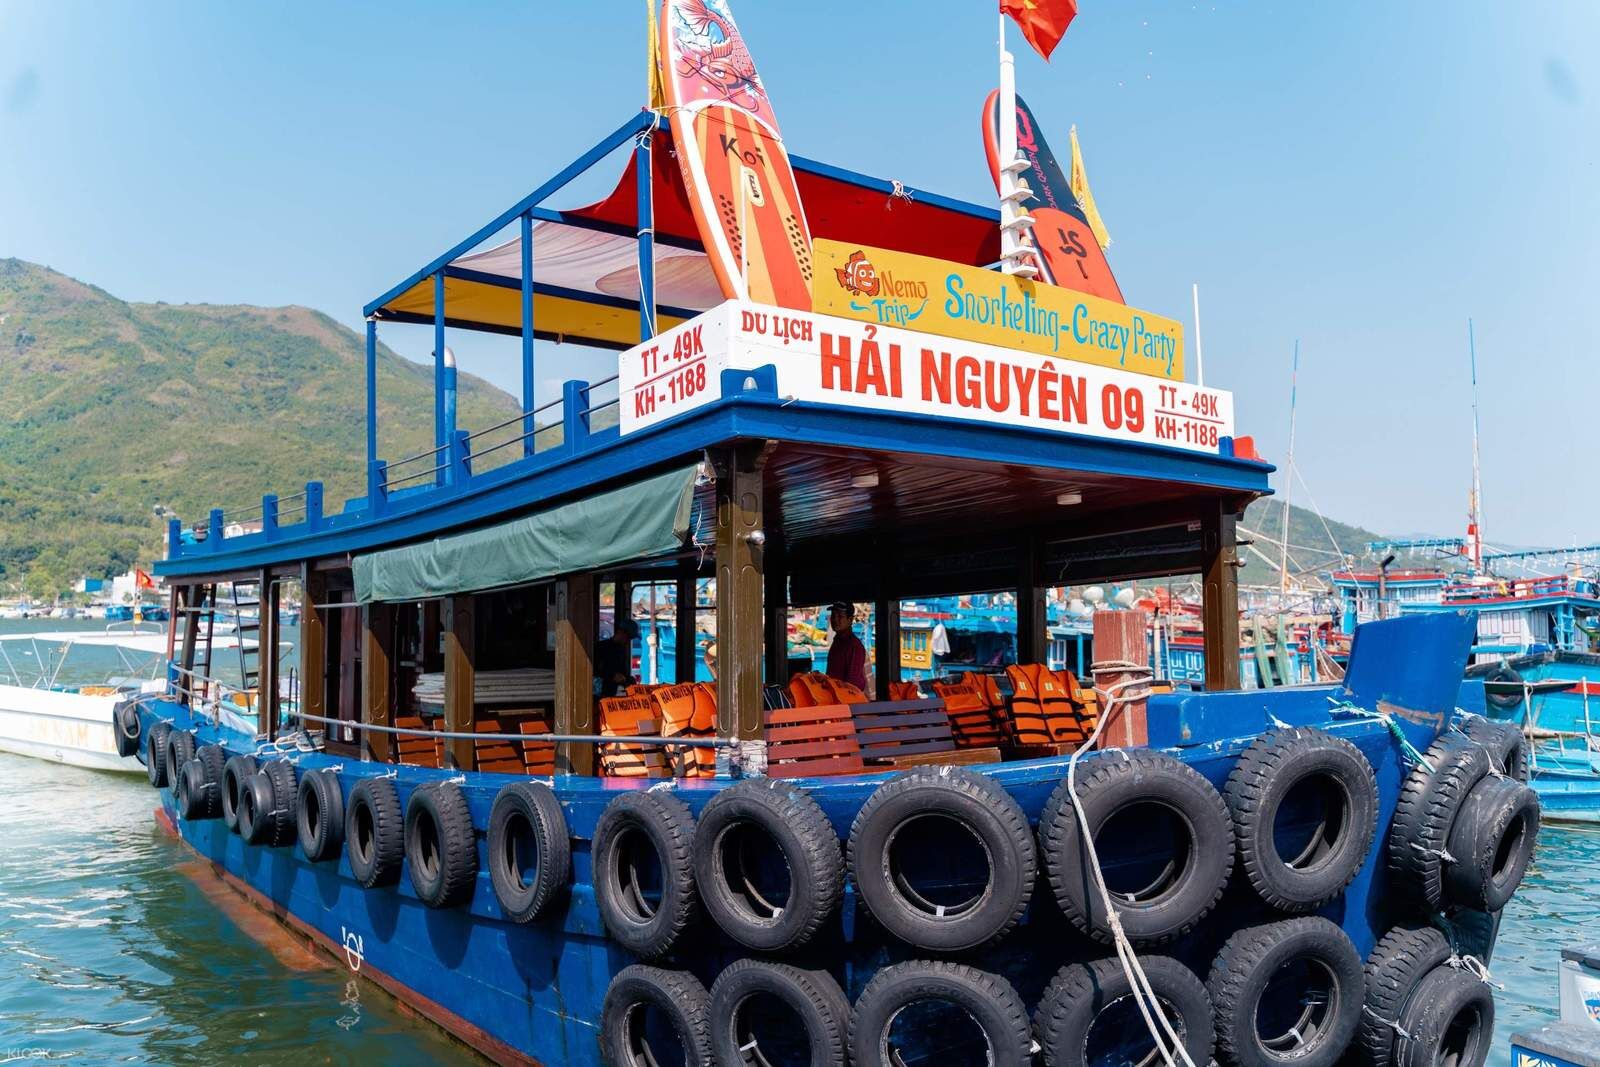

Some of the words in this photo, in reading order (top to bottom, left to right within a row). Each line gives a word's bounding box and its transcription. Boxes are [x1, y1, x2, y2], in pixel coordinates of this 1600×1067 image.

[1029, 151, 1047, 184] QUEEN
[880, 270, 928, 299] Nemo
[742, 310, 768, 335] DU
[772, 316, 813, 345] LỊCH
[871, 297, 911, 327] Trip
[641, 345, 659, 378] TT
[673, 323, 704, 363] 49K
[1133, 315, 1176, 377] Party
[668, 362, 706, 404] 1188
[820, 324, 903, 398] HẢI
[920, 348, 1088, 425] NGUYÊN
[1101, 383, 1145, 434] 09
[1159, 384, 1177, 409] TT
[1192, 391, 1218, 417] 49K
